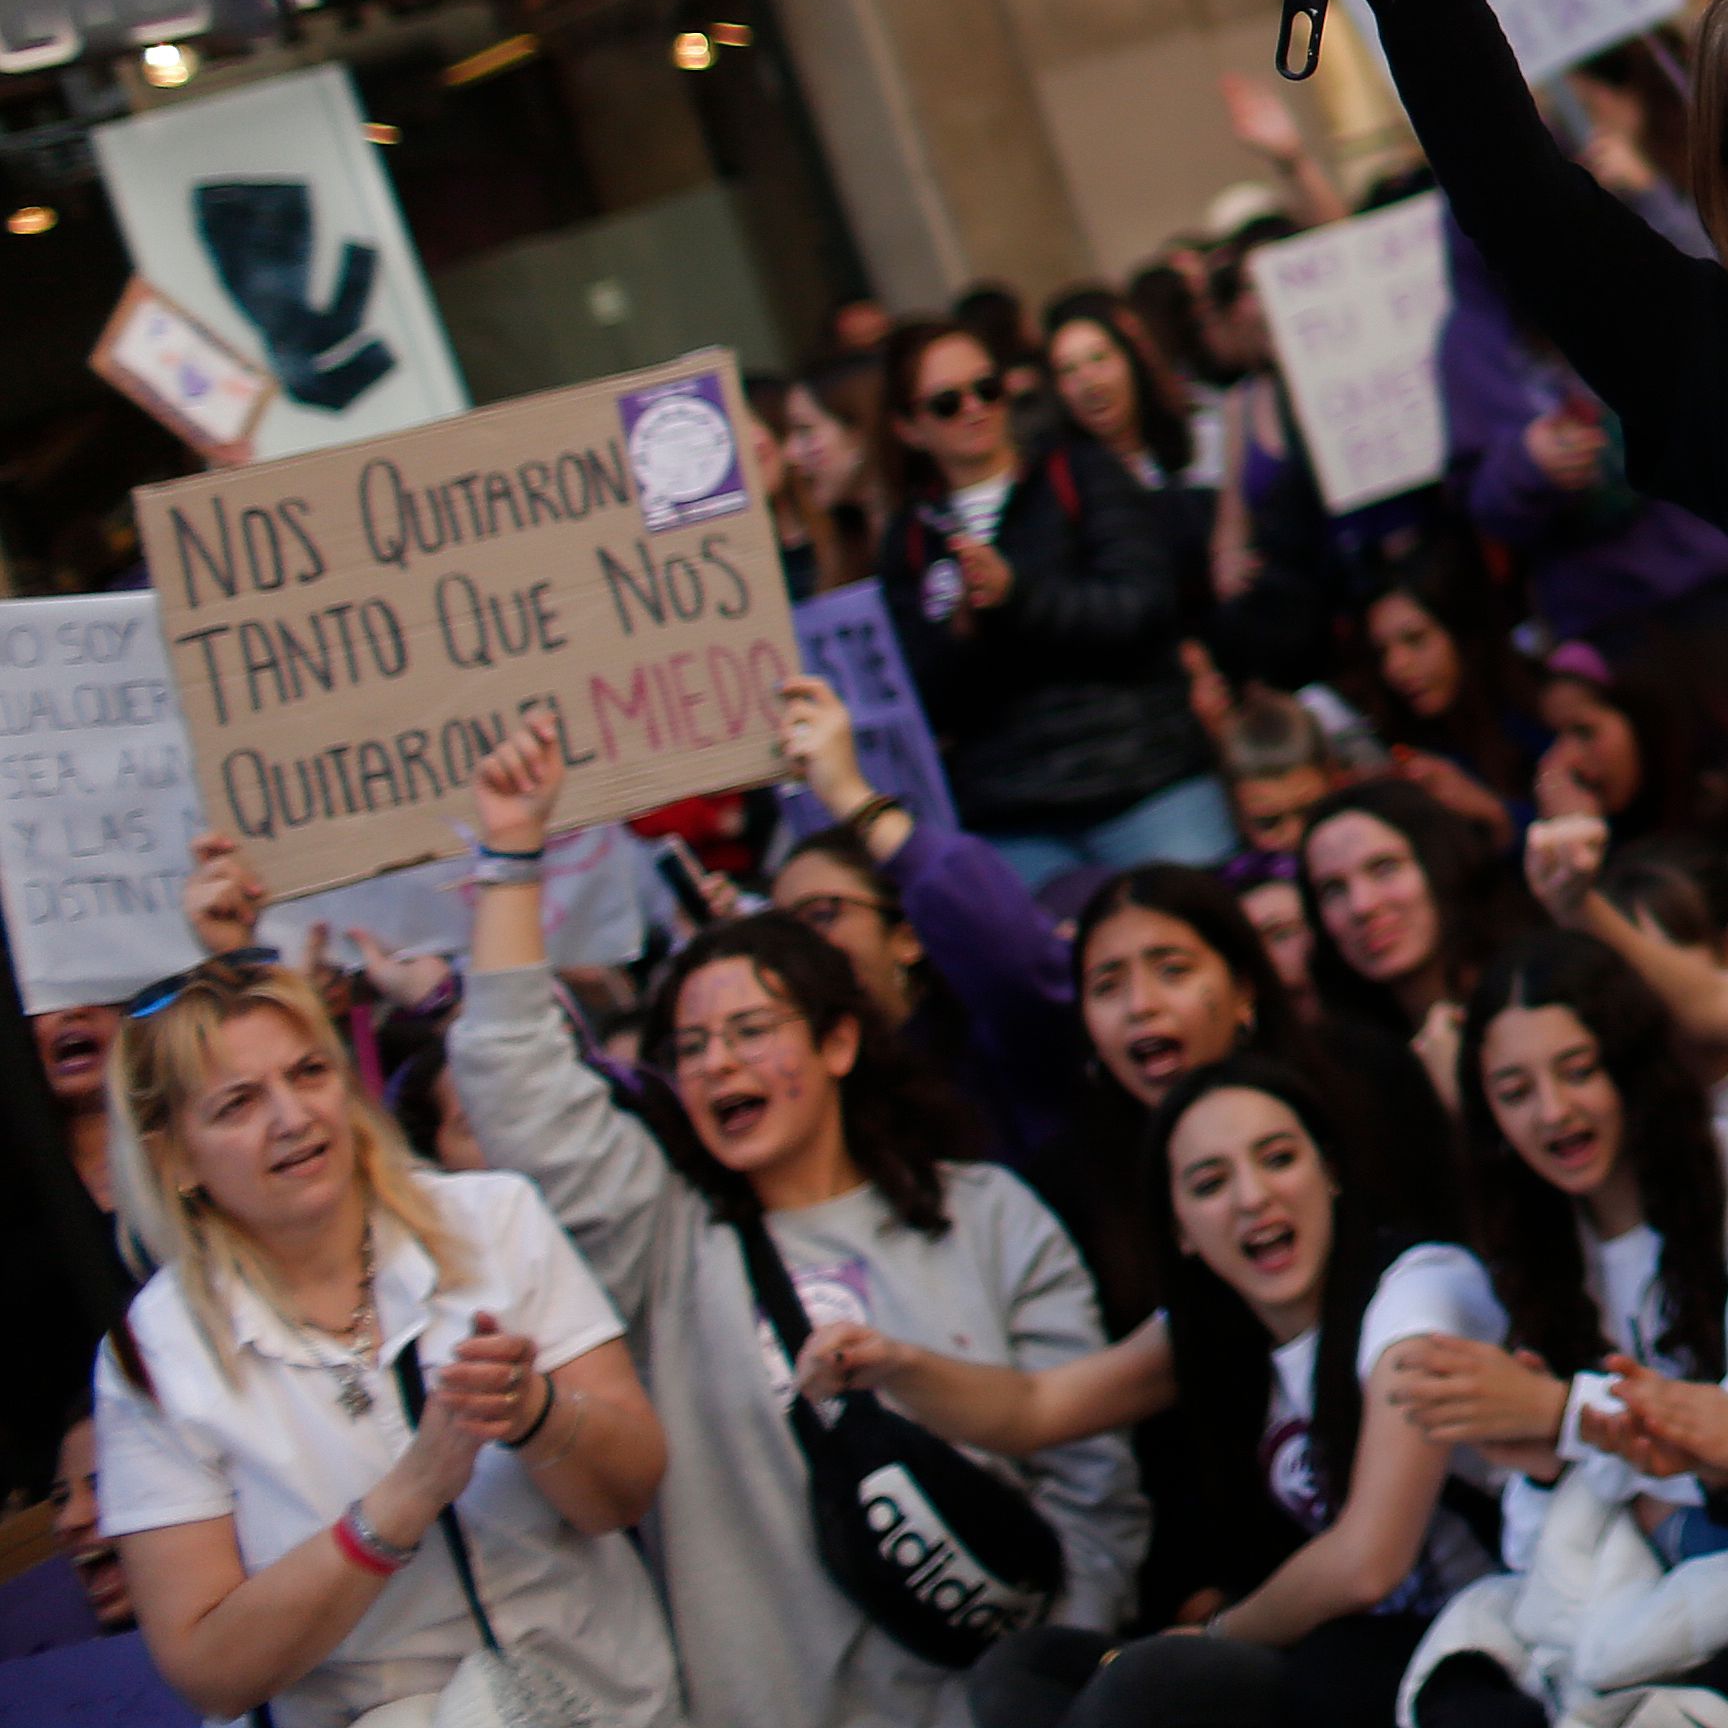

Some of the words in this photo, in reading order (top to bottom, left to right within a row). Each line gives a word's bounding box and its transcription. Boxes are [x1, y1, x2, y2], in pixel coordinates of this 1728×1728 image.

[168, 496, 325, 610] NOS
[360, 437, 631, 569] QUITARON
[176, 596, 409, 727] TANTO
[434, 572, 568, 671] QUE
[596, 534, 751, 635] NOS
[590, 638, 788, 762] MIEDO
